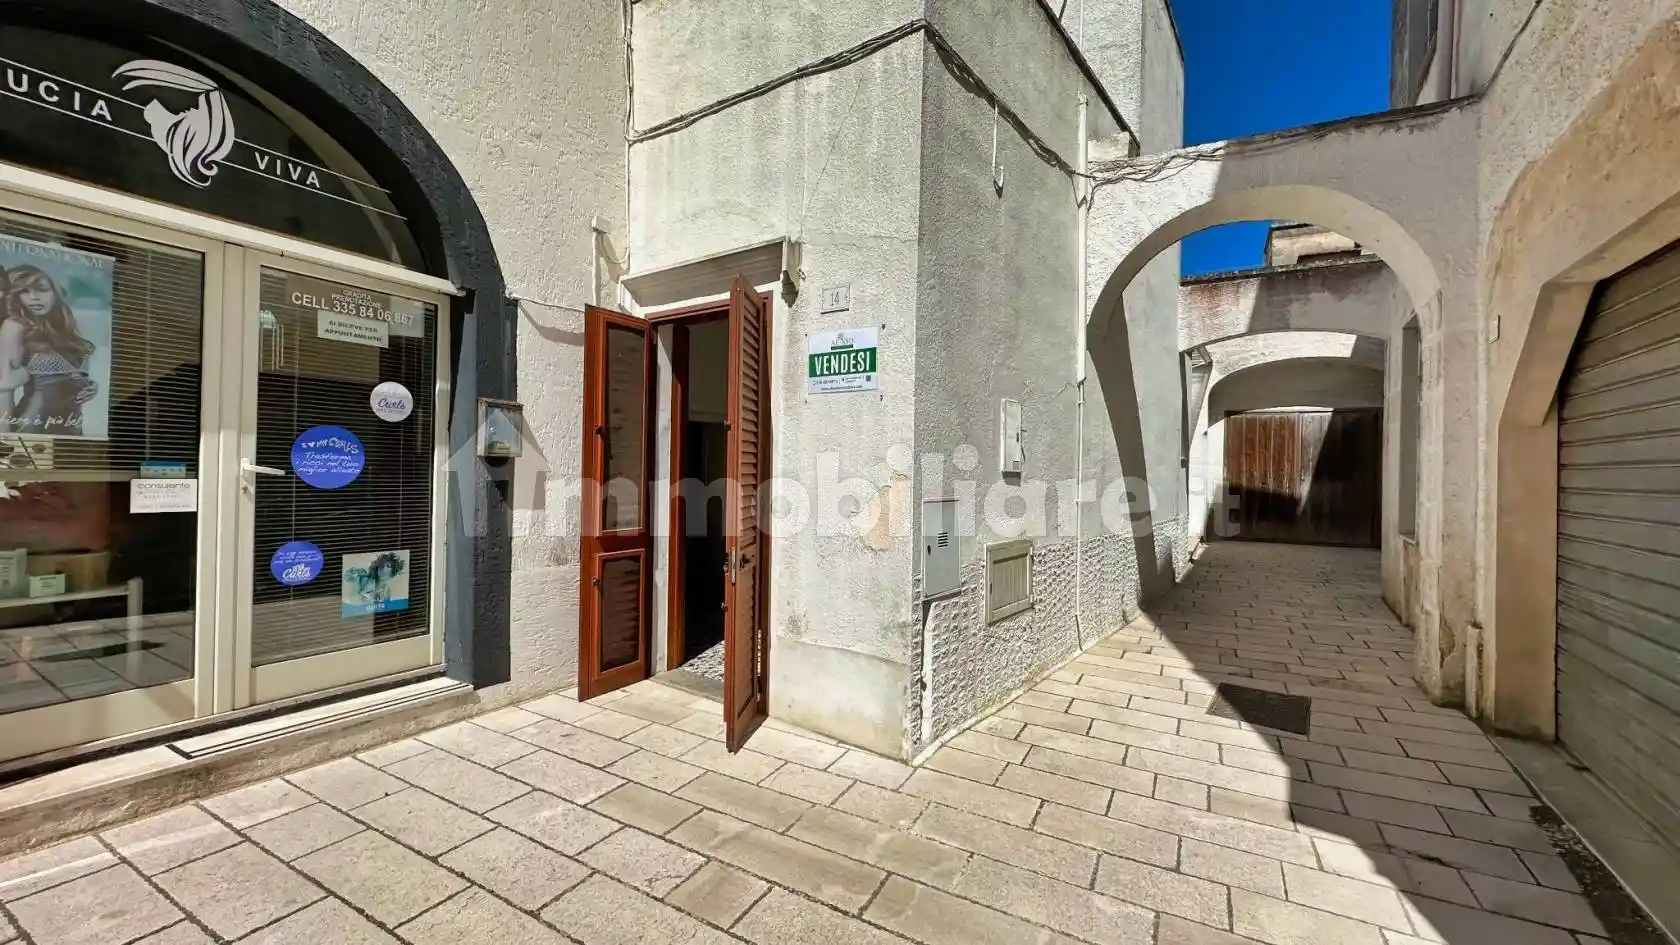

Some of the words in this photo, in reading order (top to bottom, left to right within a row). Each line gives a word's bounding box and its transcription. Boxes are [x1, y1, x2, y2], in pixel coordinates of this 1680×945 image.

[7, 68, 112, 121] UCIA
[254, 152, 321, 188] VIVA
[292, 291, 329, 310] CELL
[333, 300, 356, 315] 335
[360, 305, 374, 318] 84
[377, 309, 391, 321] 06
[394, 311, 415, 327] 867
[831, 291, 840, 306] 14
[814, 351, 870, 376] VENDESI
